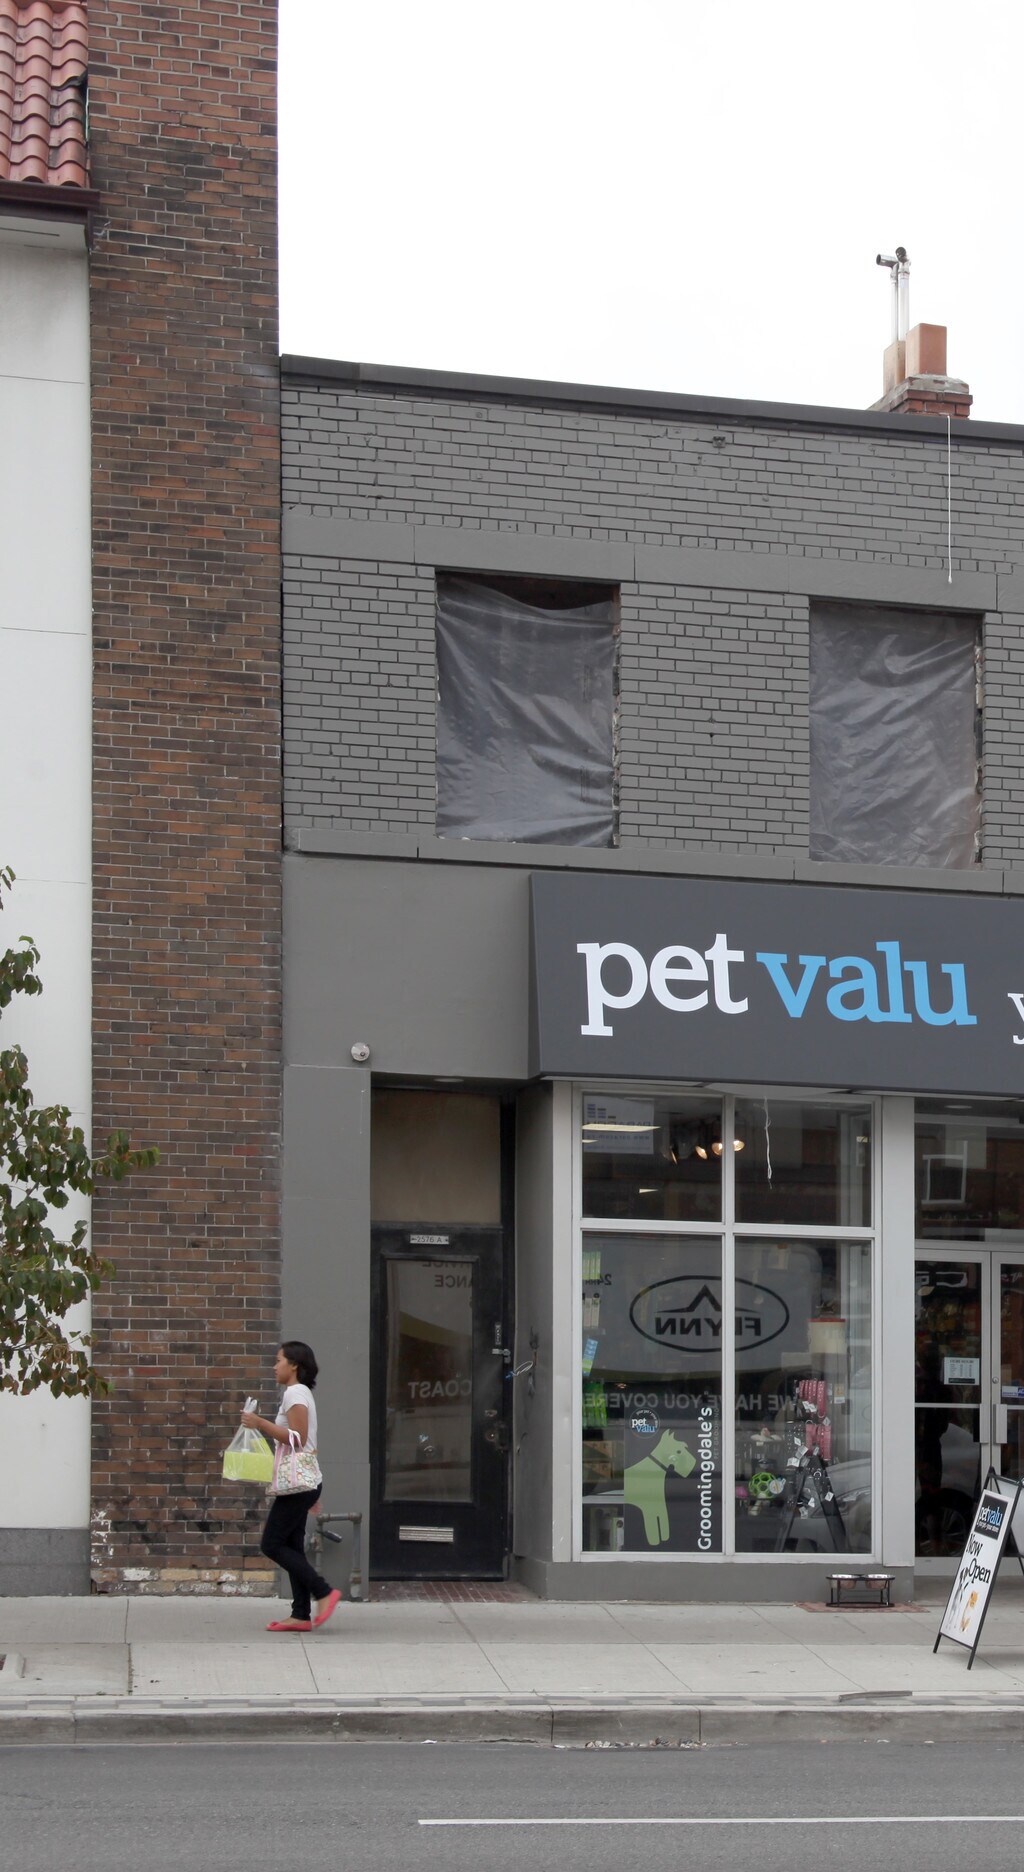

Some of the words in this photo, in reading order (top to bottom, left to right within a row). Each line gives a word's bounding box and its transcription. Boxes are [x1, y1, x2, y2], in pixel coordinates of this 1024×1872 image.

[577, 933, 748, 1037] pet
[756, 941, 977, 1026] valu
[631, 1417, 647, 1429] pet
[636, 1423, 655, 1433] valu
[697, 1407, 715, 1550] Groomingdale's
[966, 1533, 983, 1557] Now
[968, 1557, 991, 1584] Open
